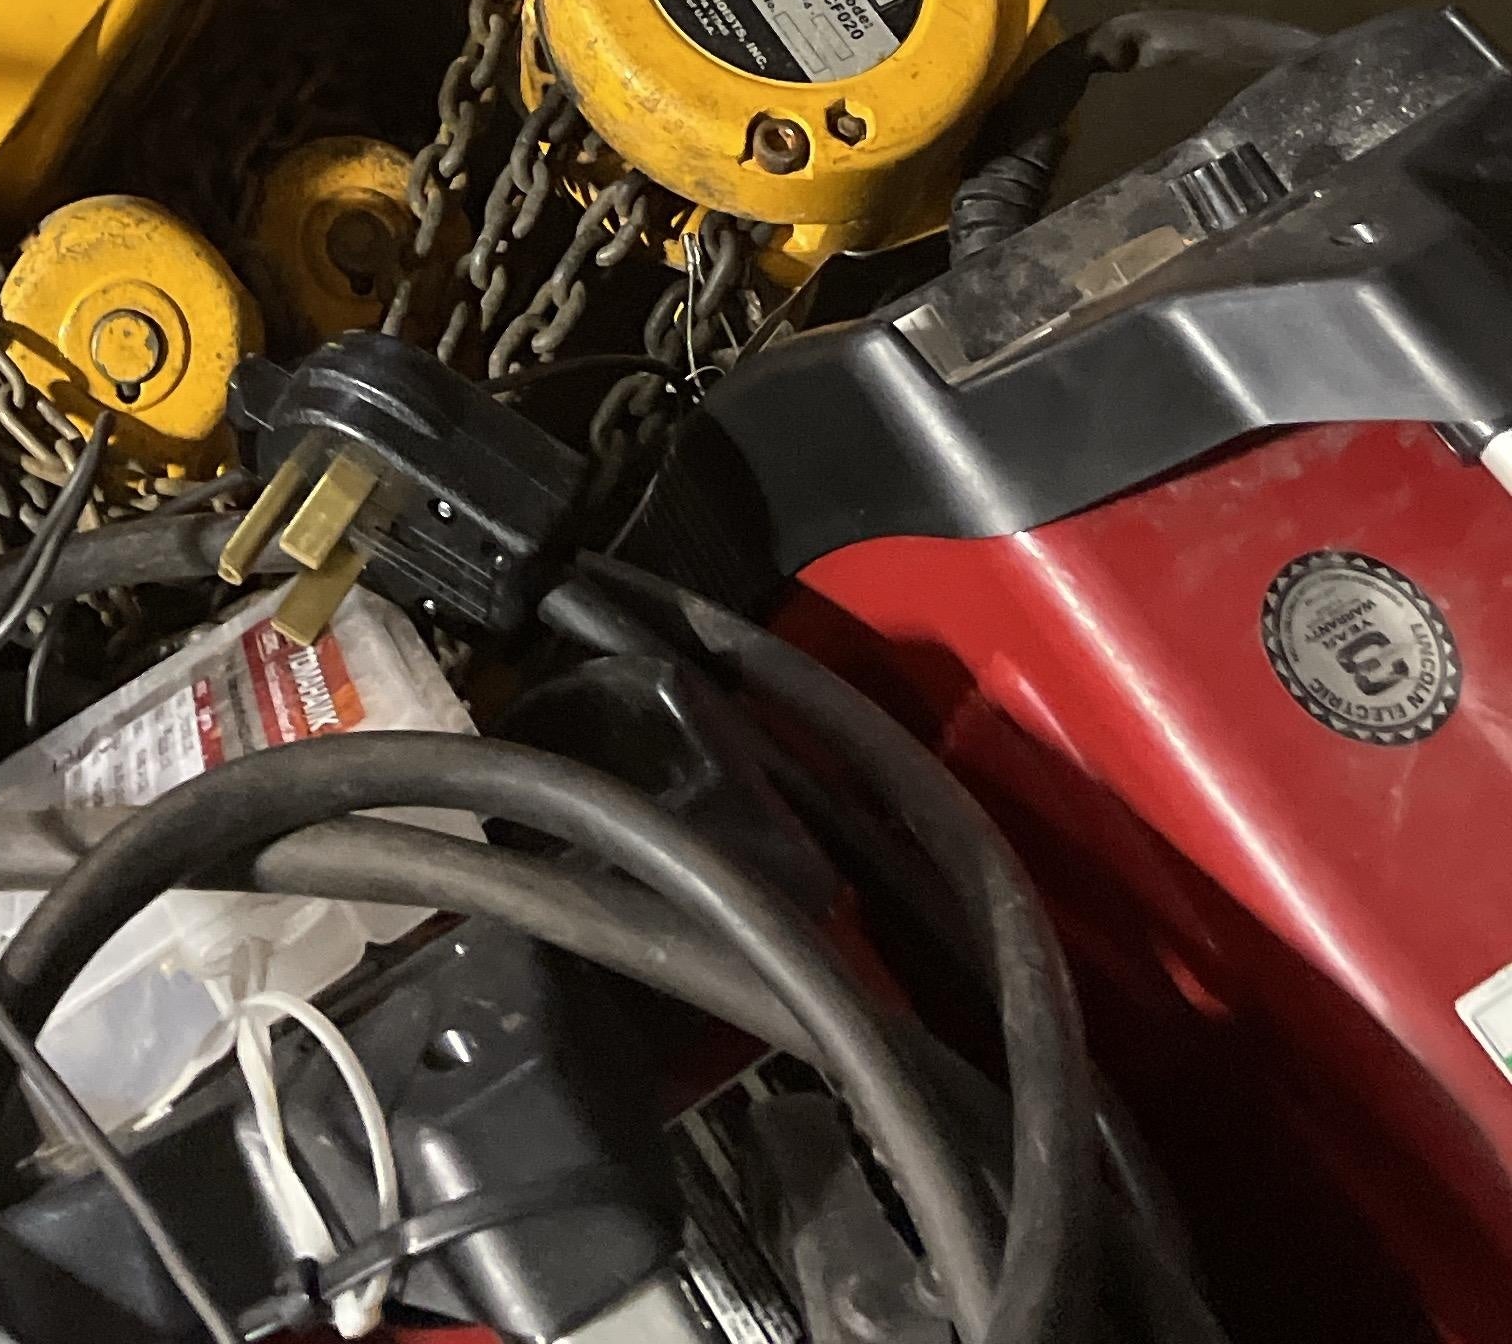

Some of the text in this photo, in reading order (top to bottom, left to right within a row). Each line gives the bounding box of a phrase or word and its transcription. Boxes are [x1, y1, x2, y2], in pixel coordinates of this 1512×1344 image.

[745, 41, 768, 71] INC.
[1303, 598, 1377, 644] WARRANTY
[1321, 619, 1374, 650] YEAR
[288, 644, 339, 733] TOMAHAWK
[1308, 622, 1437, 723] LINCOLN ELECTRIC
[1336, 630, 1410, 696] 3
